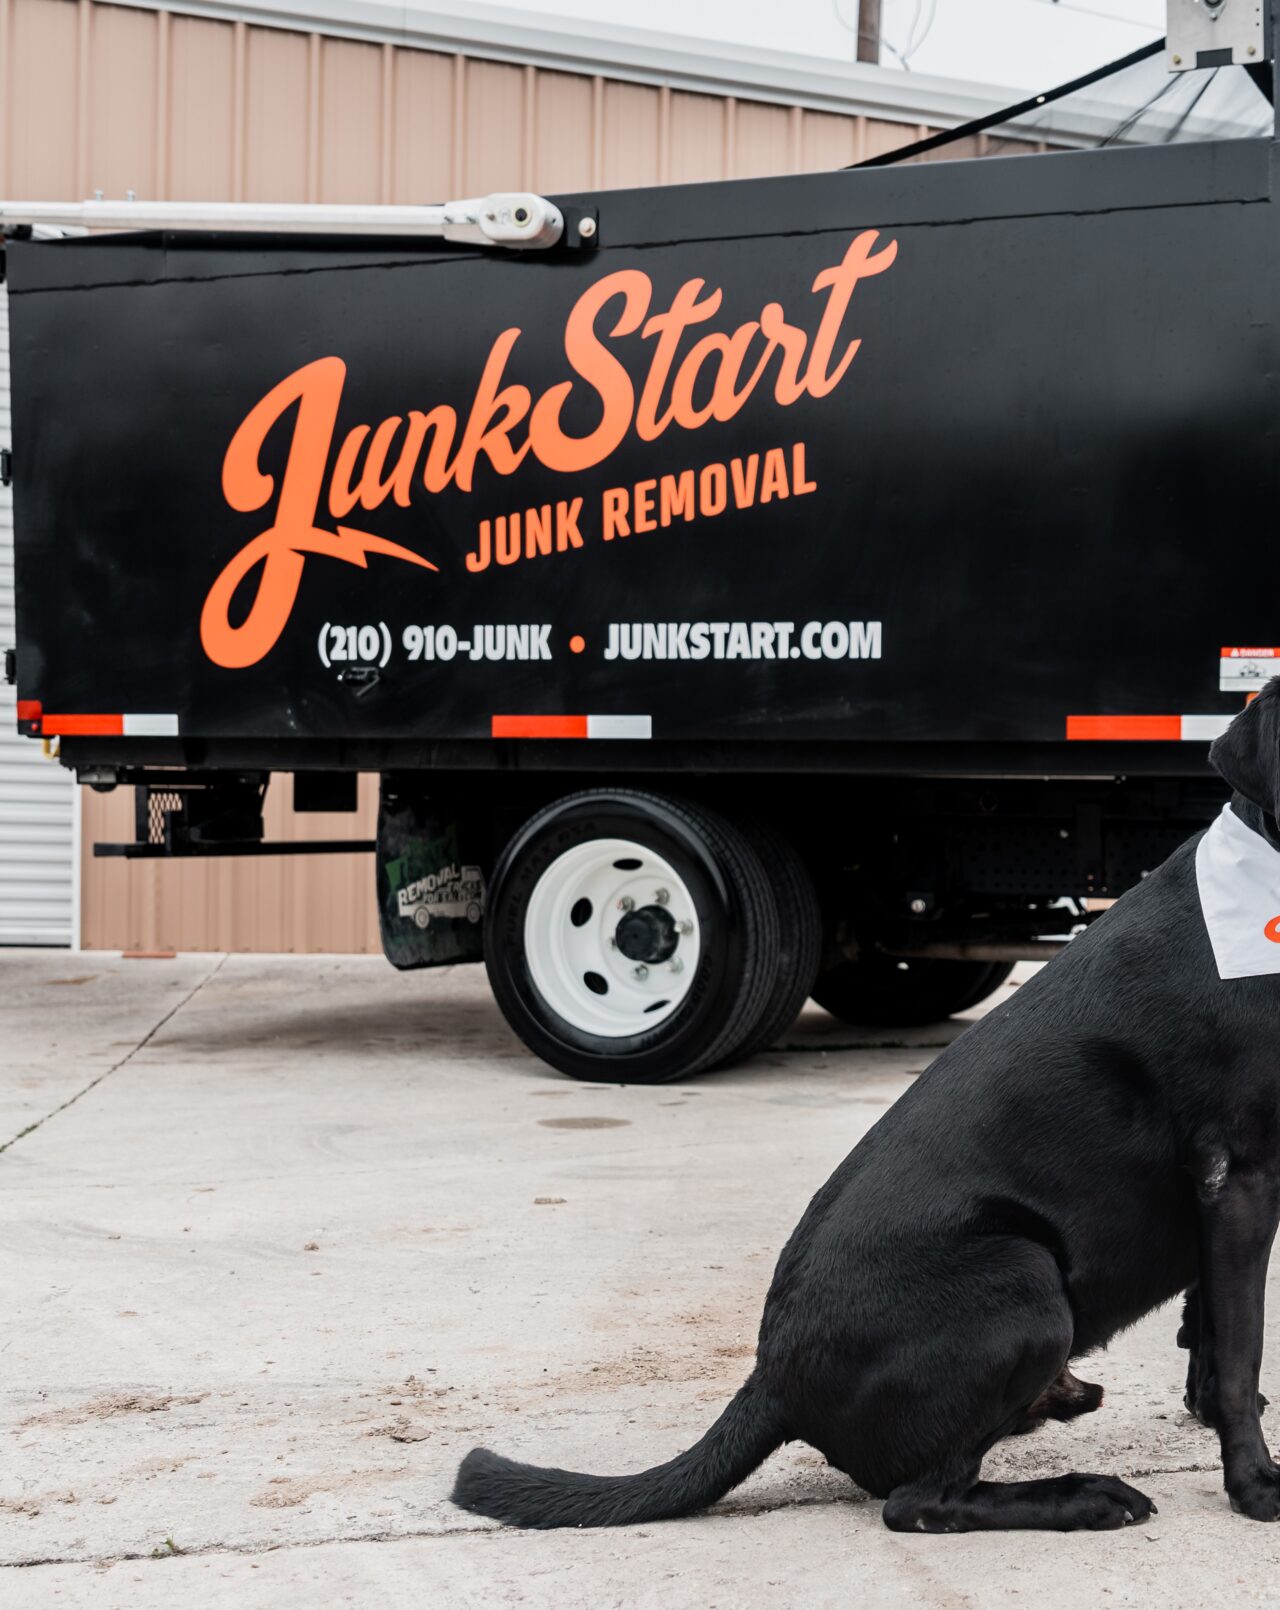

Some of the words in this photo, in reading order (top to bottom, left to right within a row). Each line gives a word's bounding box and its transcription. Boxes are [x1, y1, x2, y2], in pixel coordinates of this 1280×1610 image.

[199, 229, 899, 669] JunkStart
[465, 496, 585, 573] JUNK
[602, 441, 818, 542] REMOVAL
[317, 621, 393, 669] (210)
[402, 623, 553, 661] 910-JUNK
[603, 620, 883, 661] JUNKSTART.COM
[397, 863, 460, 904] REMOVAL
